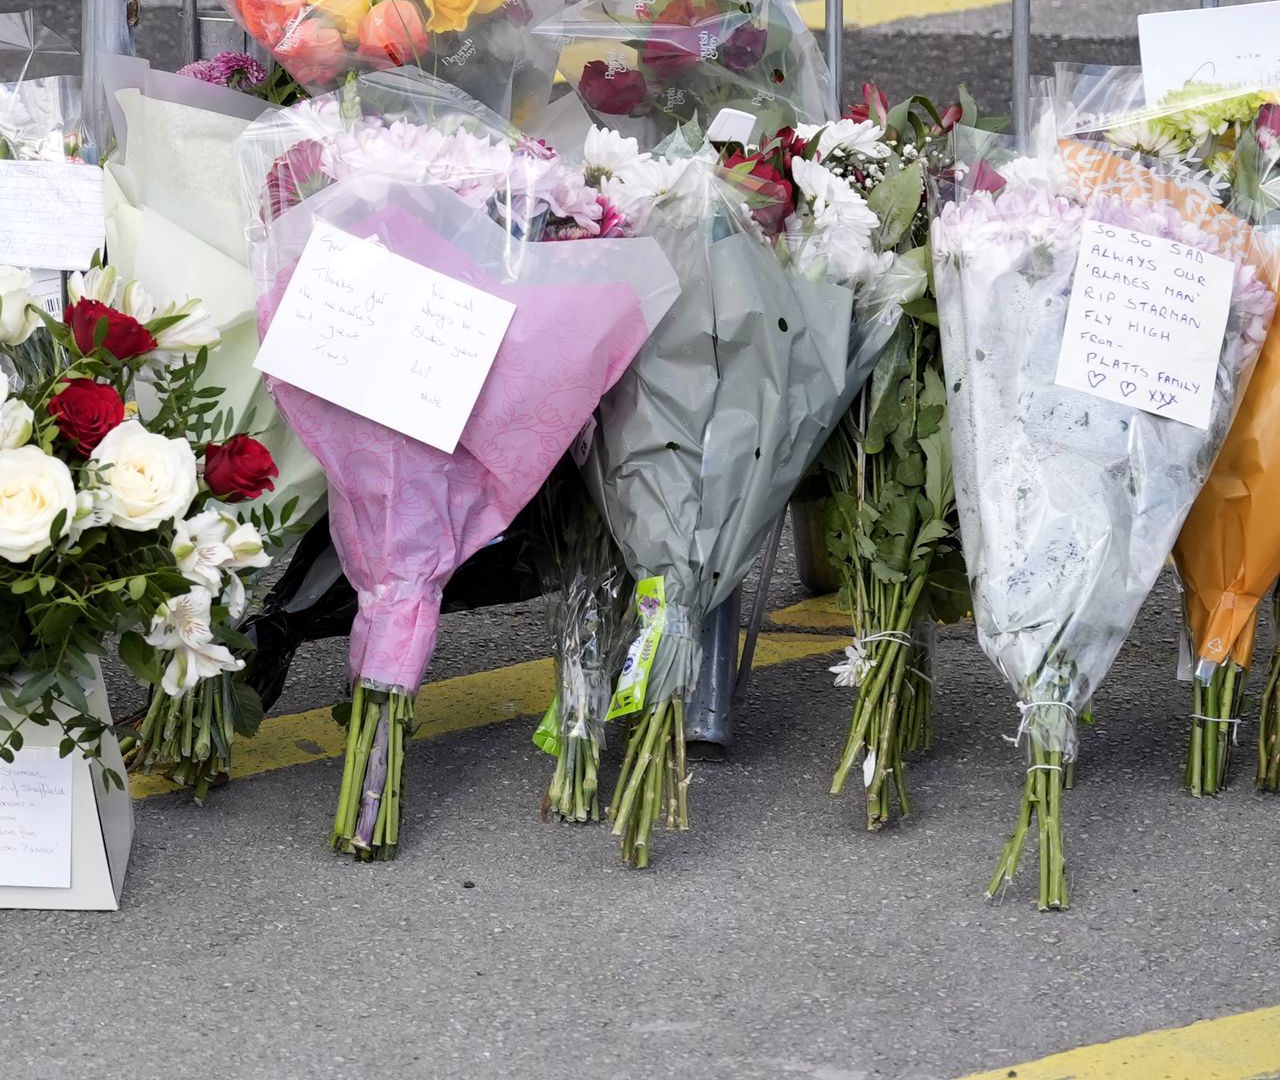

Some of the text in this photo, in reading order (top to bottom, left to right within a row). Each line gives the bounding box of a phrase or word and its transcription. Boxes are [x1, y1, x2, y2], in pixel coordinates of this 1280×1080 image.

[441, 38, 473, 67] Flourish
[1093, 224, 1204, 264] SO SO SAD
[1091, 244, 1207, 287] ALWAYS OUR
[1084, 286, 1201, 329] RIP STARMAN
[1084, 310, 1170, 342] FLY HIGH
[1086, 351, 1202, 395] PLATTS FAMILY
